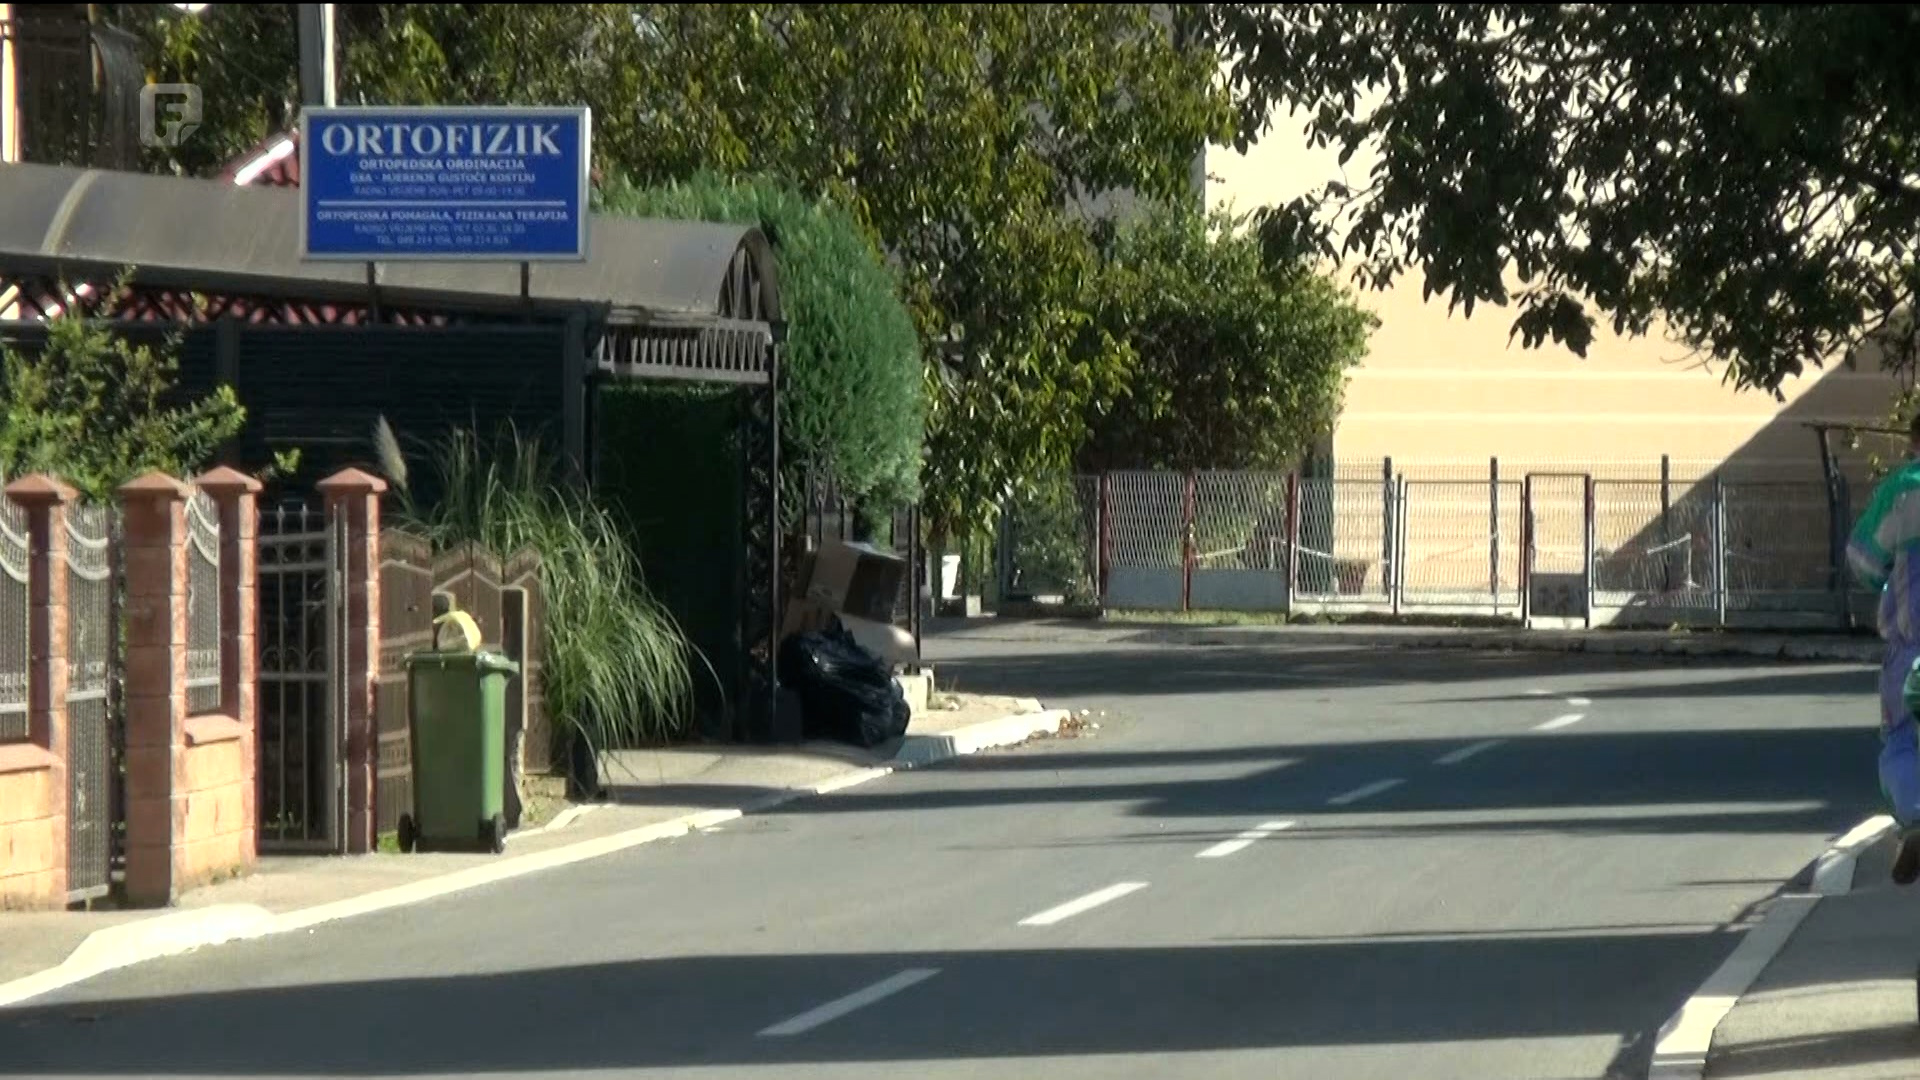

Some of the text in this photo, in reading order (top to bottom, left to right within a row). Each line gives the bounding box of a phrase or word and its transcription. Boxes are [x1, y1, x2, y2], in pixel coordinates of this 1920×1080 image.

[321, 123, 561, 155] ORTOFIZIK
[359, 158, 526, 170] ORTOPEDSKA ORDINACIJA
[489, 172, 536, 183] KOSTIJU
[316, 211, 389, 221] ORTOPEDSKA
[514, 211, 568, 221] TERAPIJA
